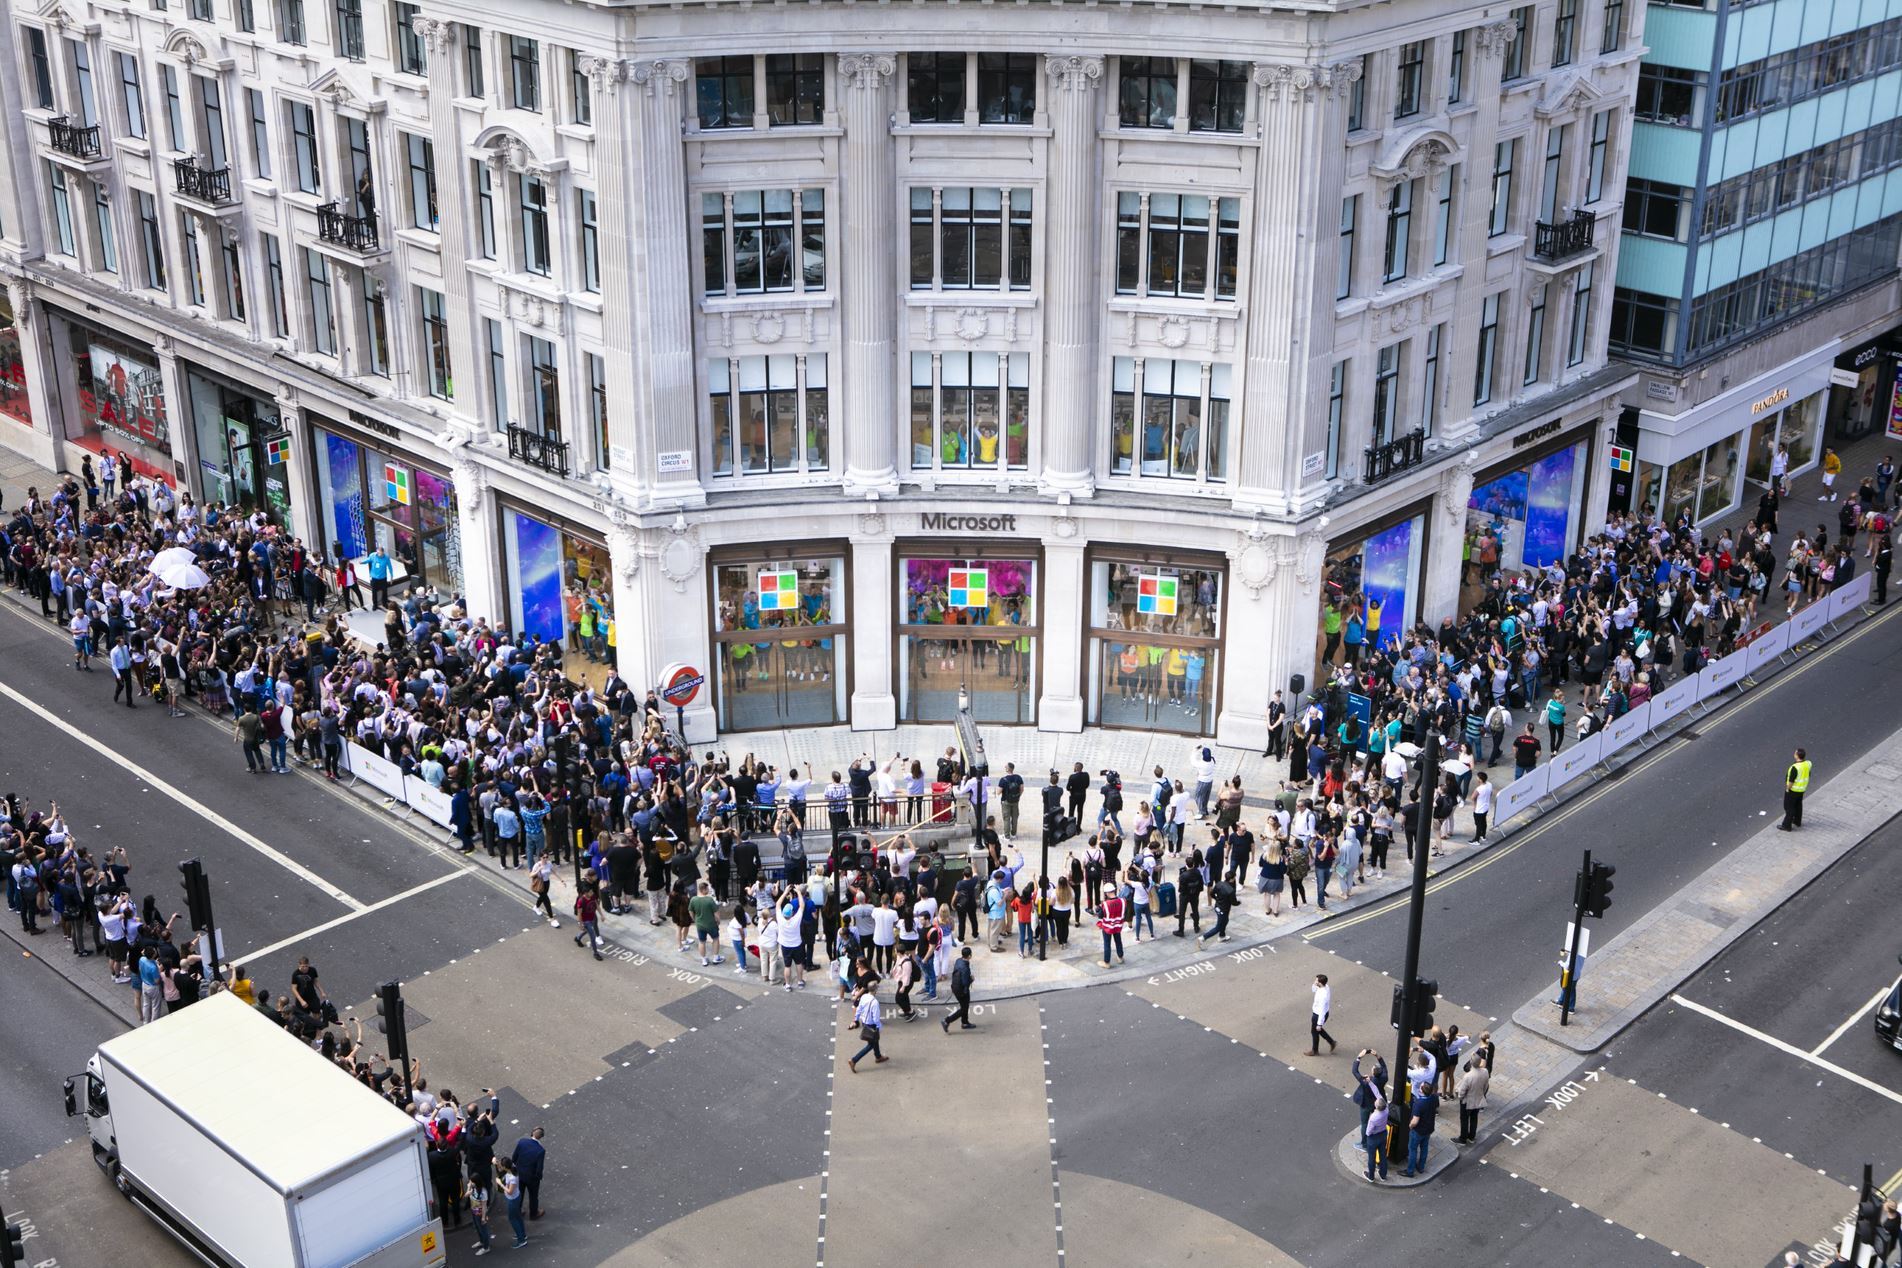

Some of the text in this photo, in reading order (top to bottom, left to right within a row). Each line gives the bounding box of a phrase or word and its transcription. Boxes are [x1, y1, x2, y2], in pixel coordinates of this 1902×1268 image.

[80, 389, 159, 442] SALE
[130, 434, 146, 446] OFF
[661, 459, 680, 467] CIRCUS
[921, 512, 1016, 532] Microsoft
[665, 677, 703, 696] UNDERGROUND
[1164, 943, 1278, 983] LOOK RIGHT
[667, 967, 713, 989] LOOK
[1501, 1081, 1587, 1146] LOOK LEFT
